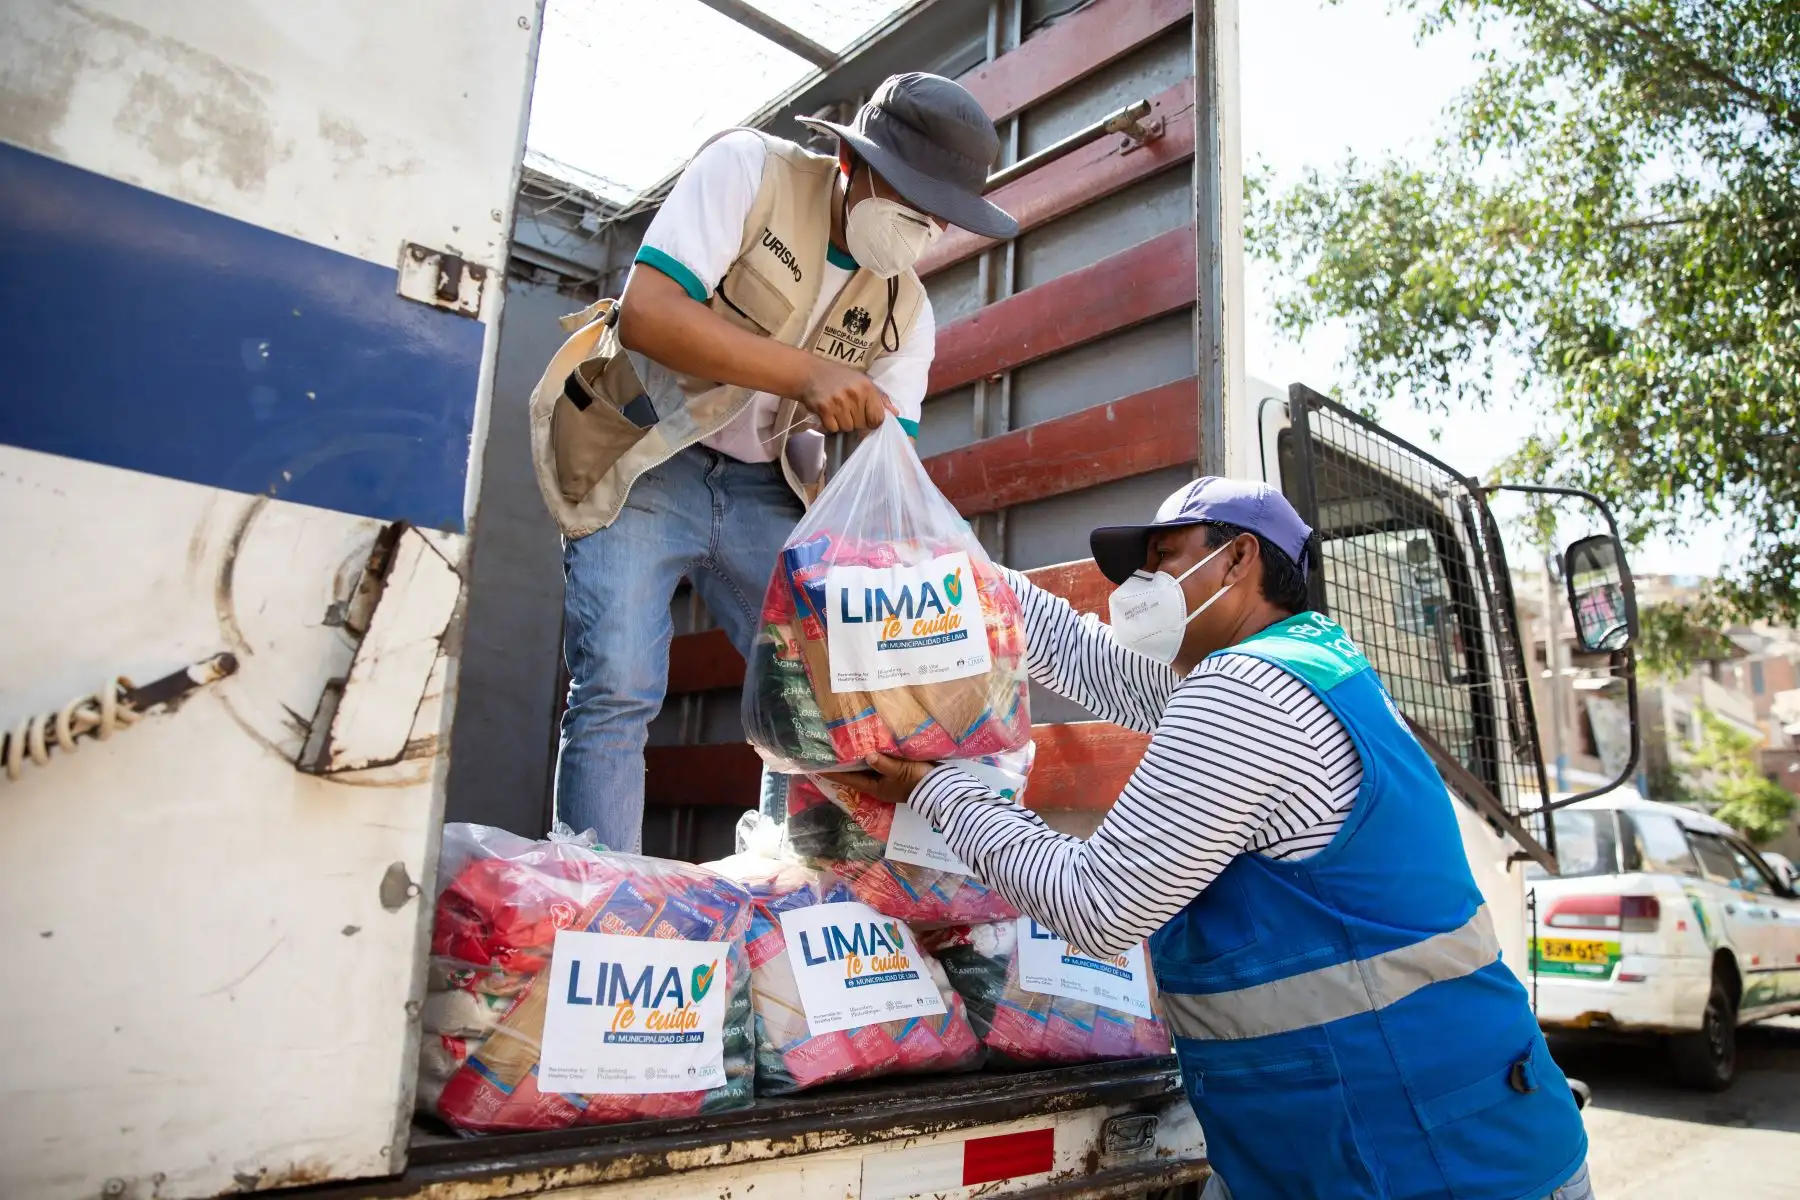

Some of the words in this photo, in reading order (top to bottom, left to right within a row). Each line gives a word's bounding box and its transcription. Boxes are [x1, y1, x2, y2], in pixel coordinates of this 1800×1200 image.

[760, 227, 802, 283] TURISMO
[841, 581, 945, 623] LIMA
[911, 606, 962, 636] cuida
[889, 638, 942, 649] MUNICIPALIDAD
[942, 635, 951, 643] DE
[951, 632, 966, 641] LIMA
[799, 922, 894, 967] LIMA
[871, 948, 910, 974] cuida
[567, 960, 684, 1009] LIMA
[856, 975, 898, 985] MUNICIPALIDAD
[645, 1001, 700, 1035] cuida
[618, 1034, 675, 1043] MUNICIPALIDAD
[686, 1034, 702, 1042] LIMA
